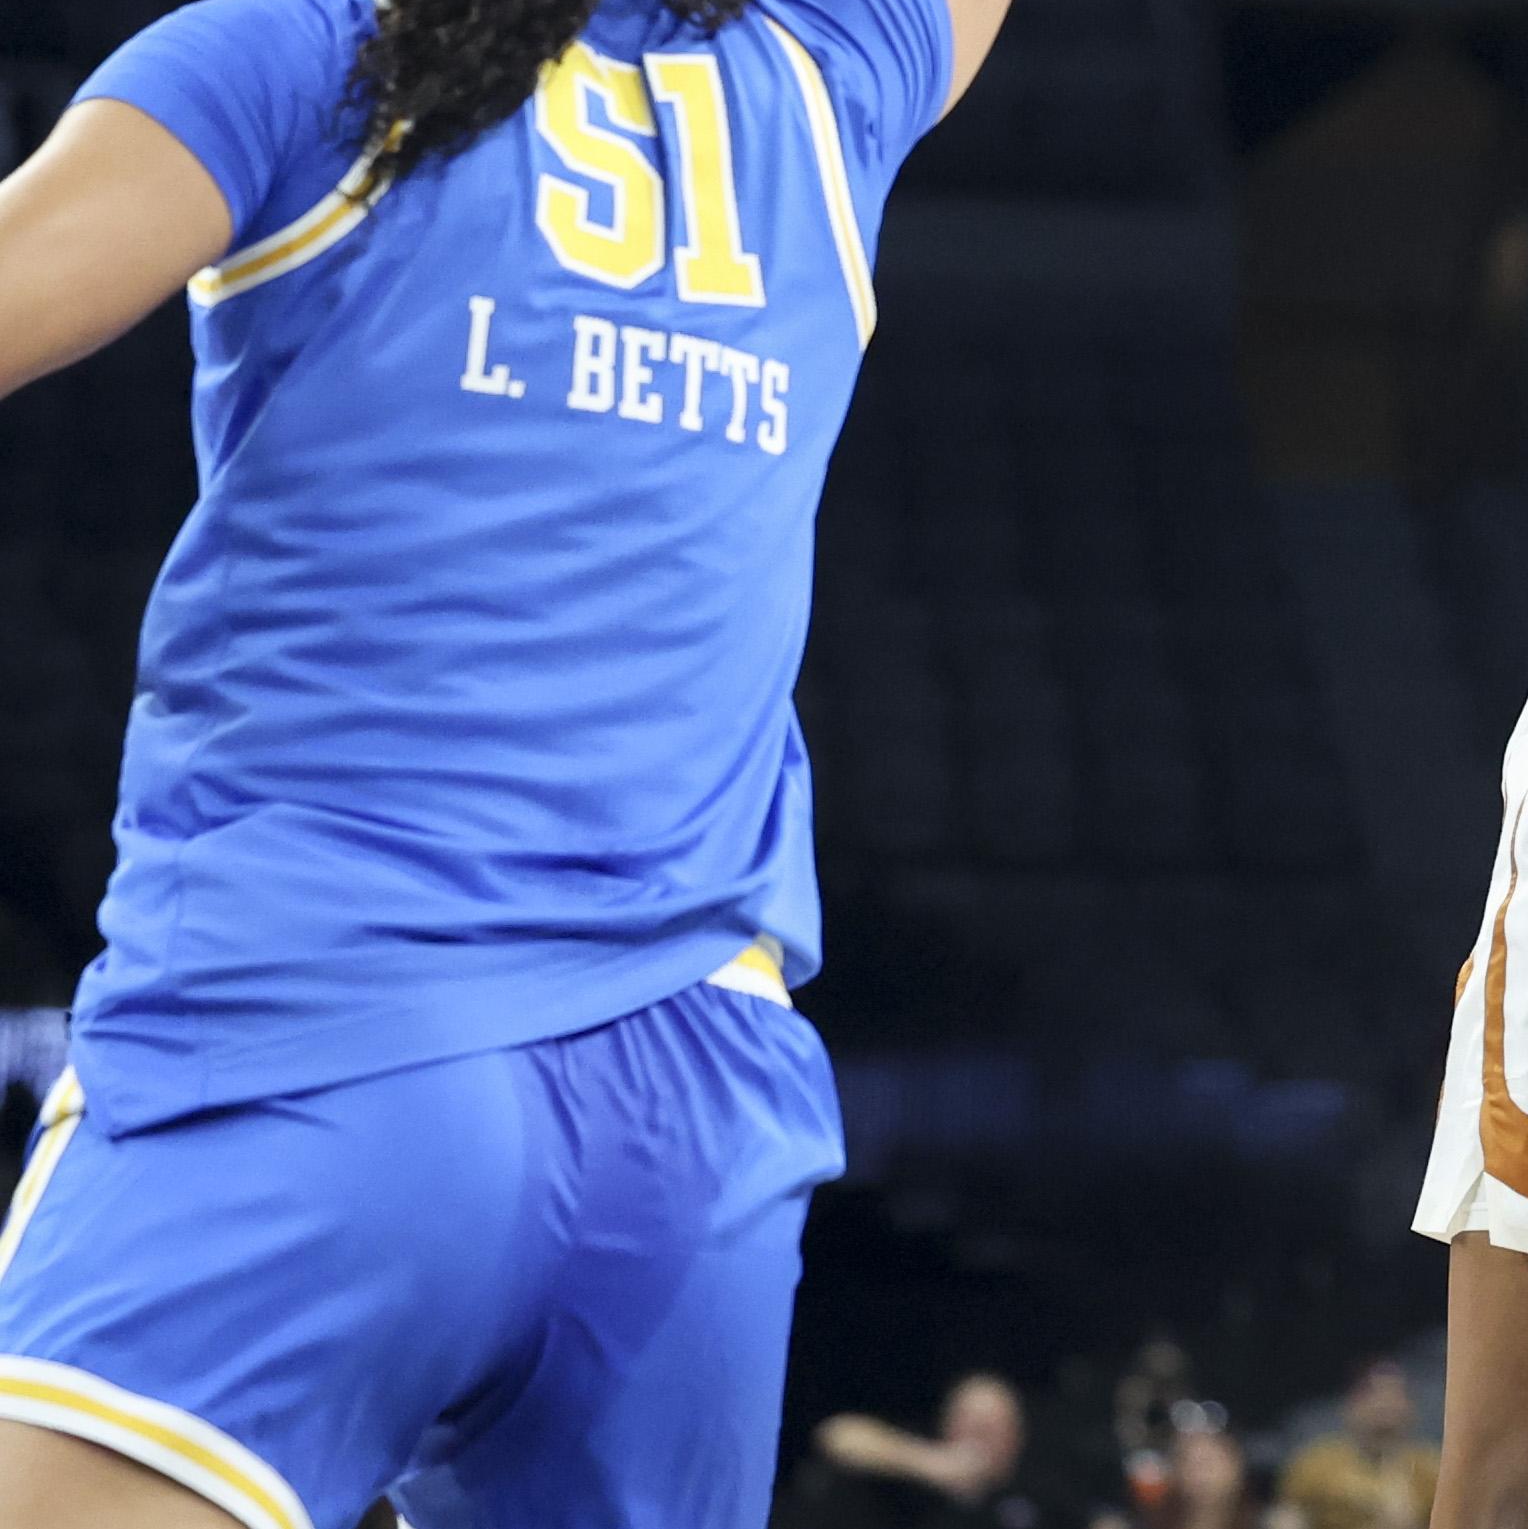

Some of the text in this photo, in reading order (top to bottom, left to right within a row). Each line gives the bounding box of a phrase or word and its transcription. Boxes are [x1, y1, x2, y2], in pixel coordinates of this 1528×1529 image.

[534, 40, 766, 307] 51
[460, 295, 790, 457] L. BETTS
